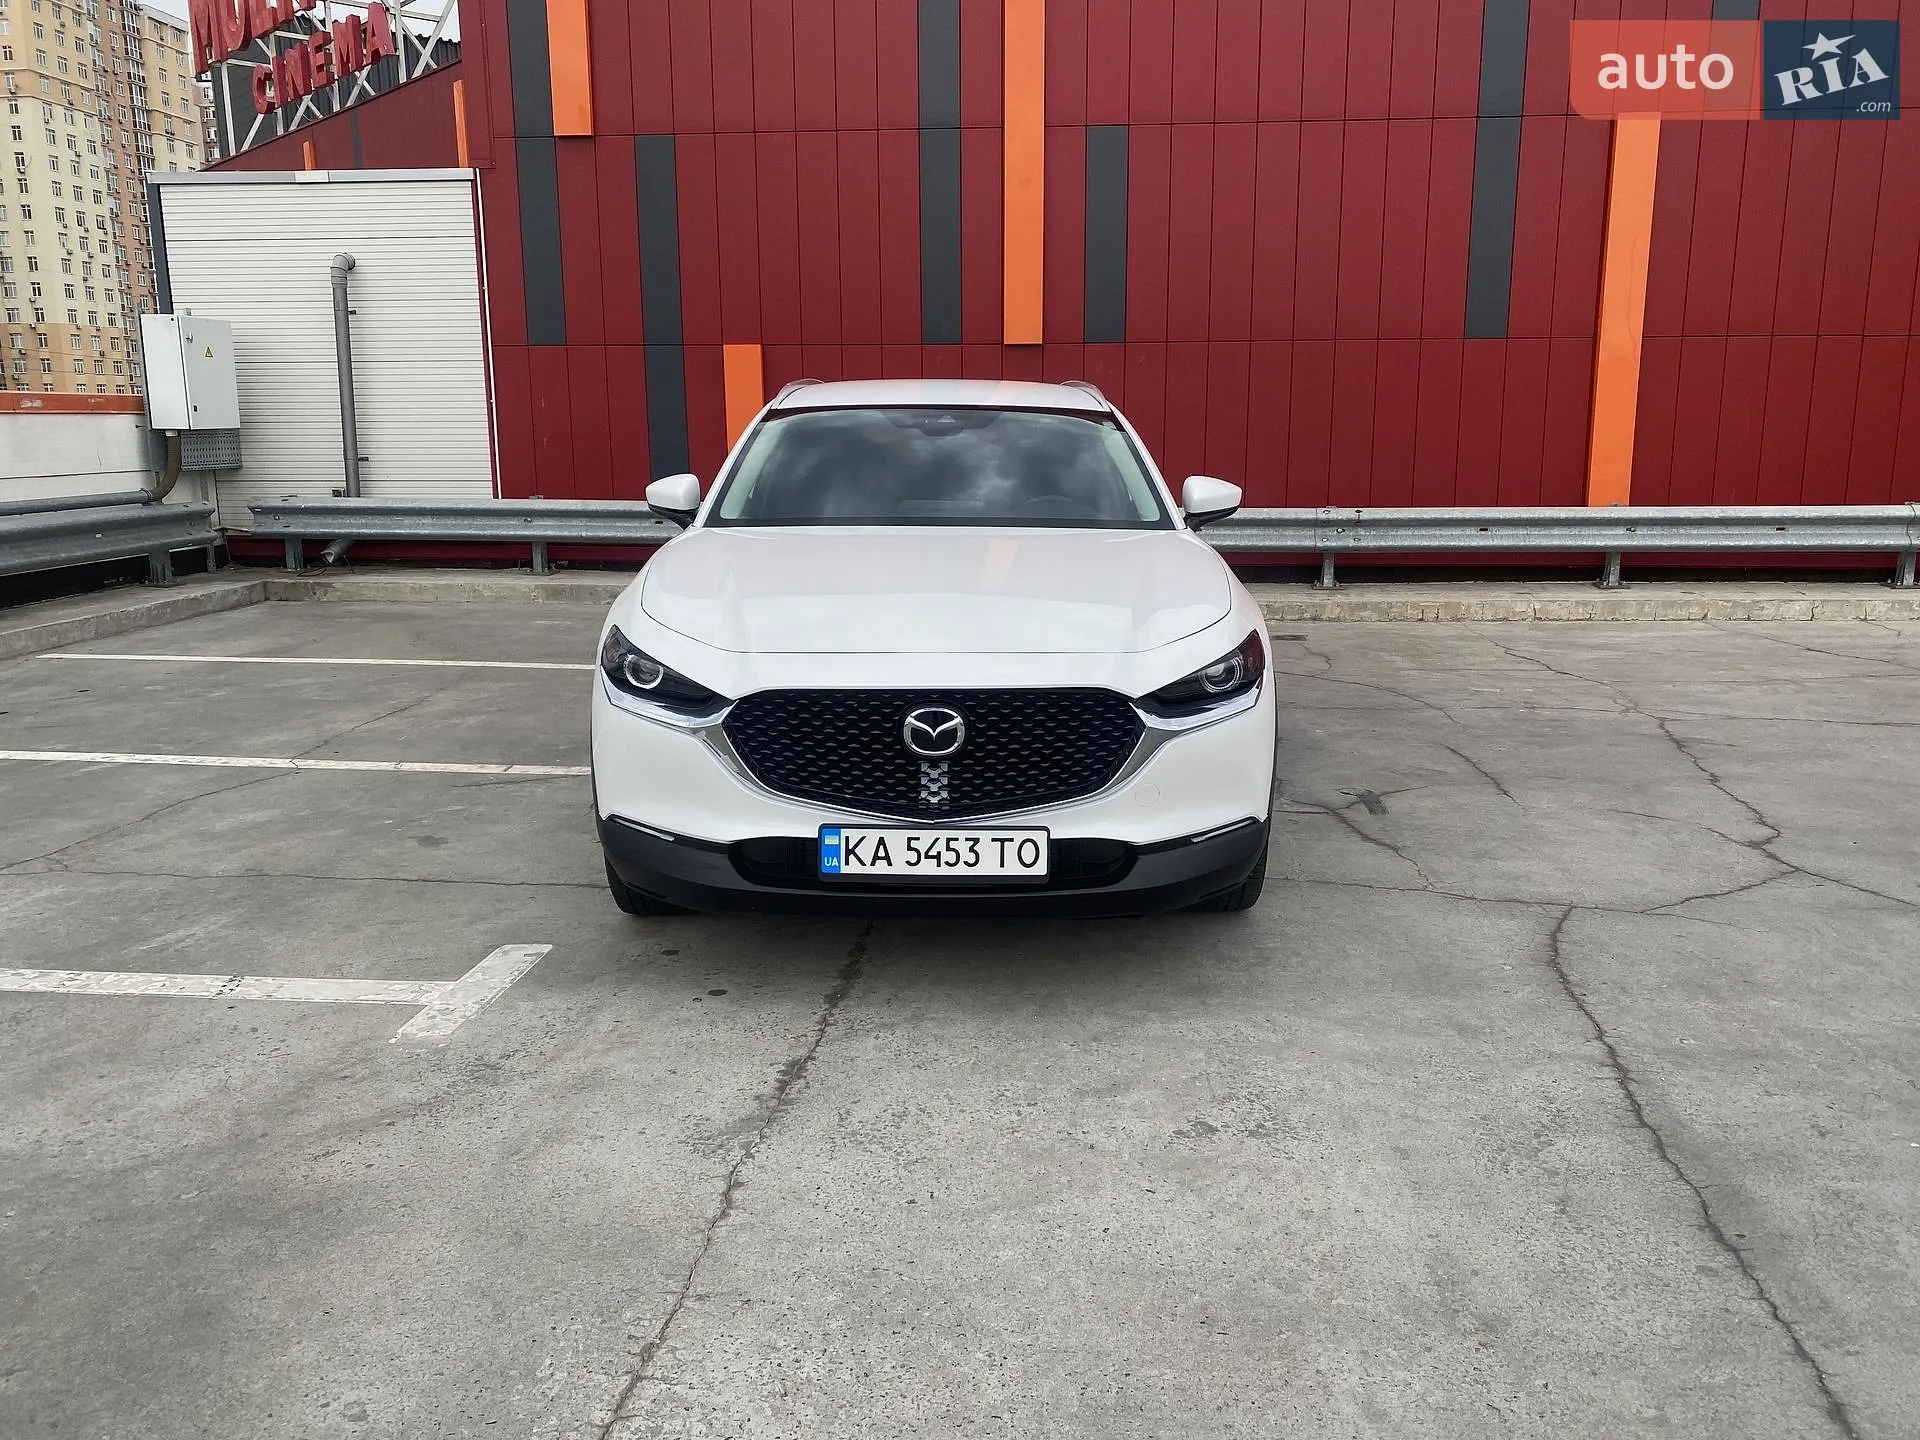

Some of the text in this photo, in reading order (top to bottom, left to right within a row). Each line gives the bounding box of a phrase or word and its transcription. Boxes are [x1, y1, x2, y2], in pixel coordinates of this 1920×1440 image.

[252, 2, 398, 114] CINEMA
[824, 857, 839, 867] UA
[844, 835, 1040, 868] KA 5453 TO
